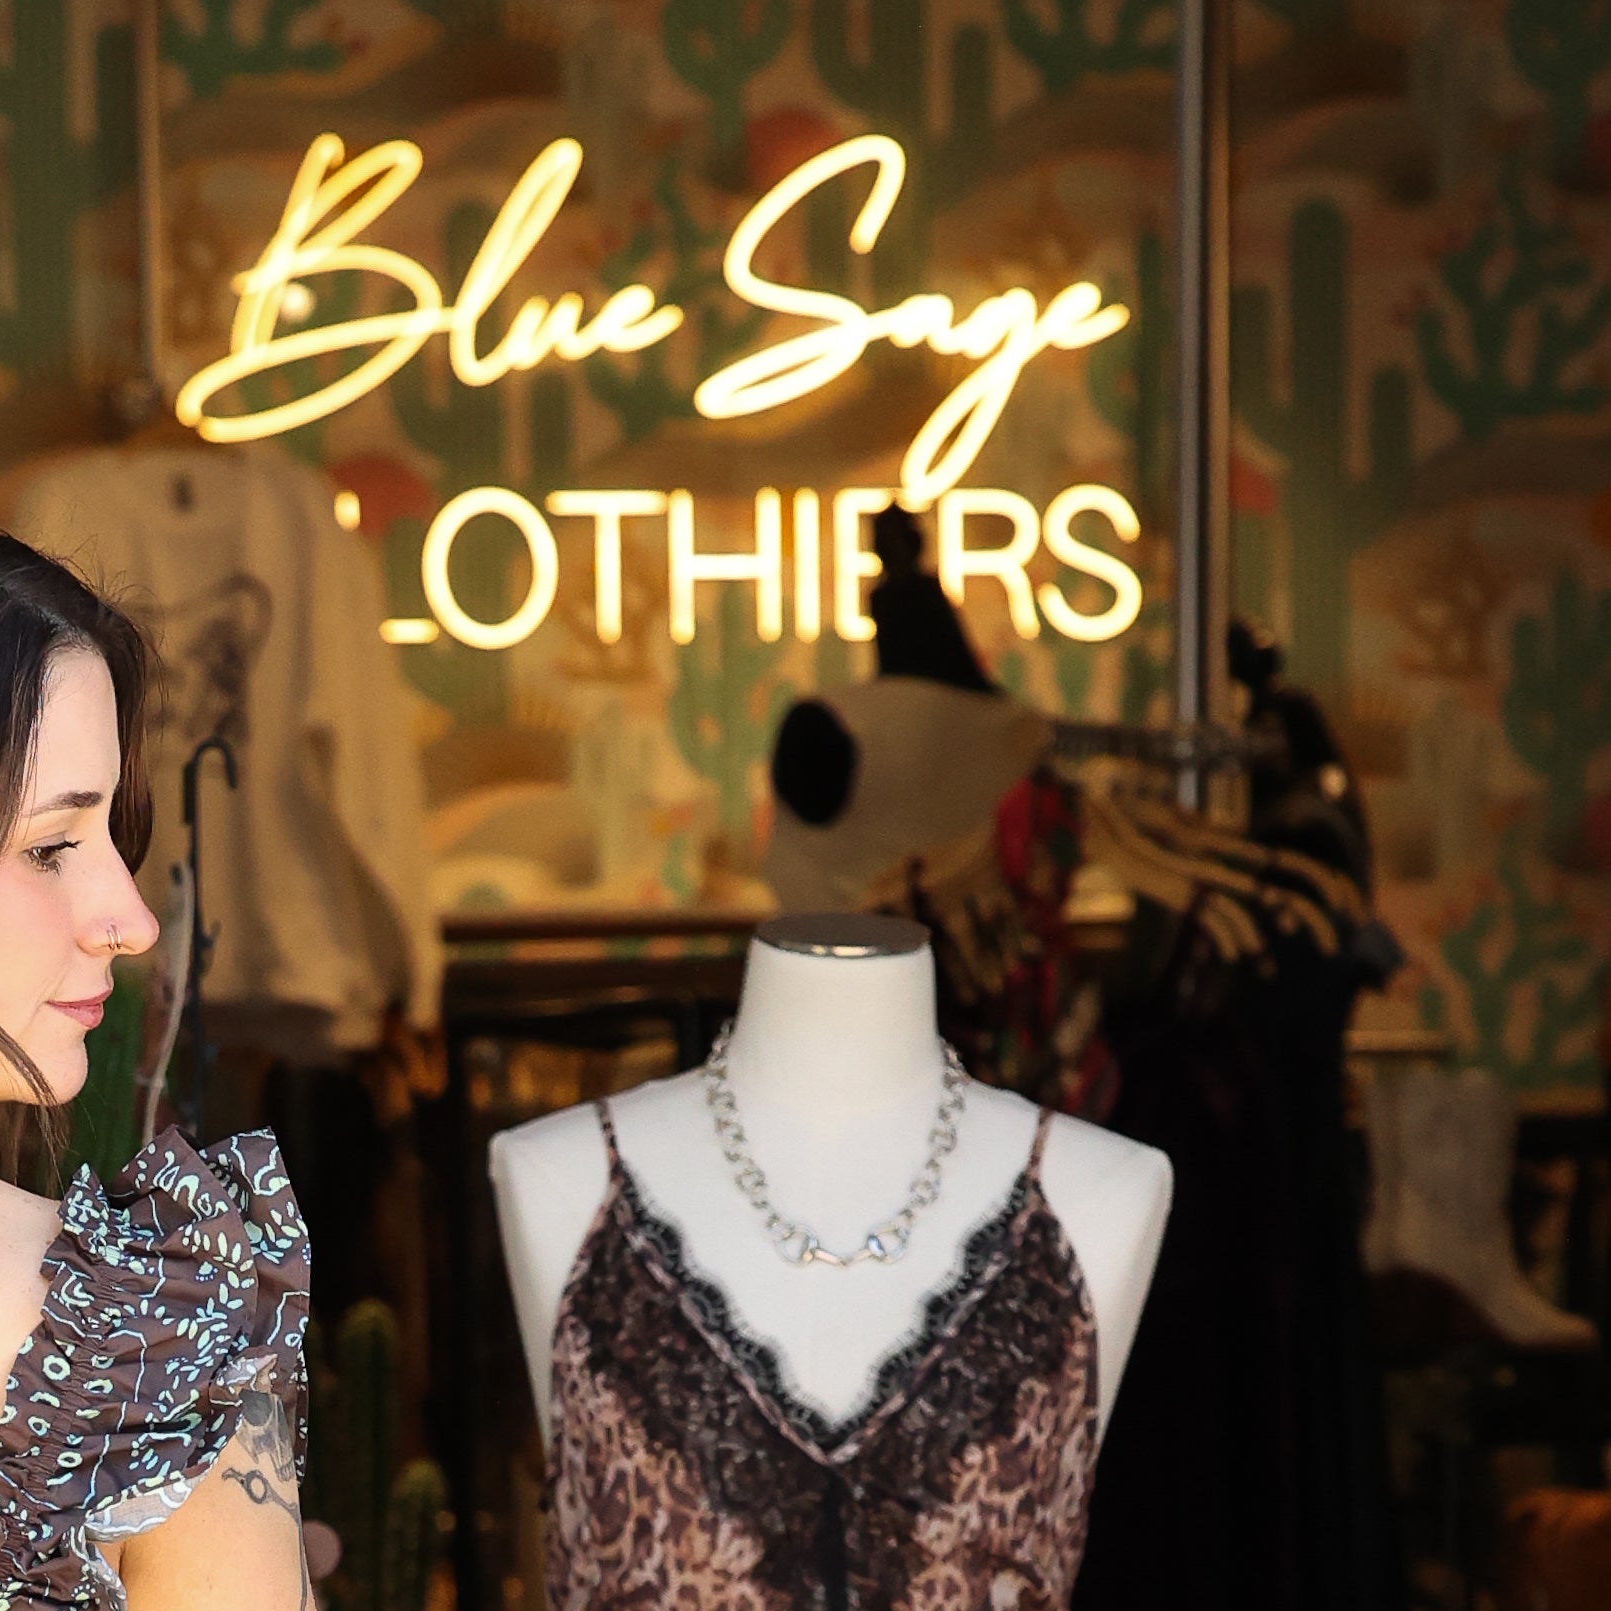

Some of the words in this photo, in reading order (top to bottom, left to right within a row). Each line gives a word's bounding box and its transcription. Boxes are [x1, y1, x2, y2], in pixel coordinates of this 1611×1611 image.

[176, 133, 685, 444] Blue
[693, 133, 1131, 506] Sage
[334, 484, 1143, 650] OTHIERS
